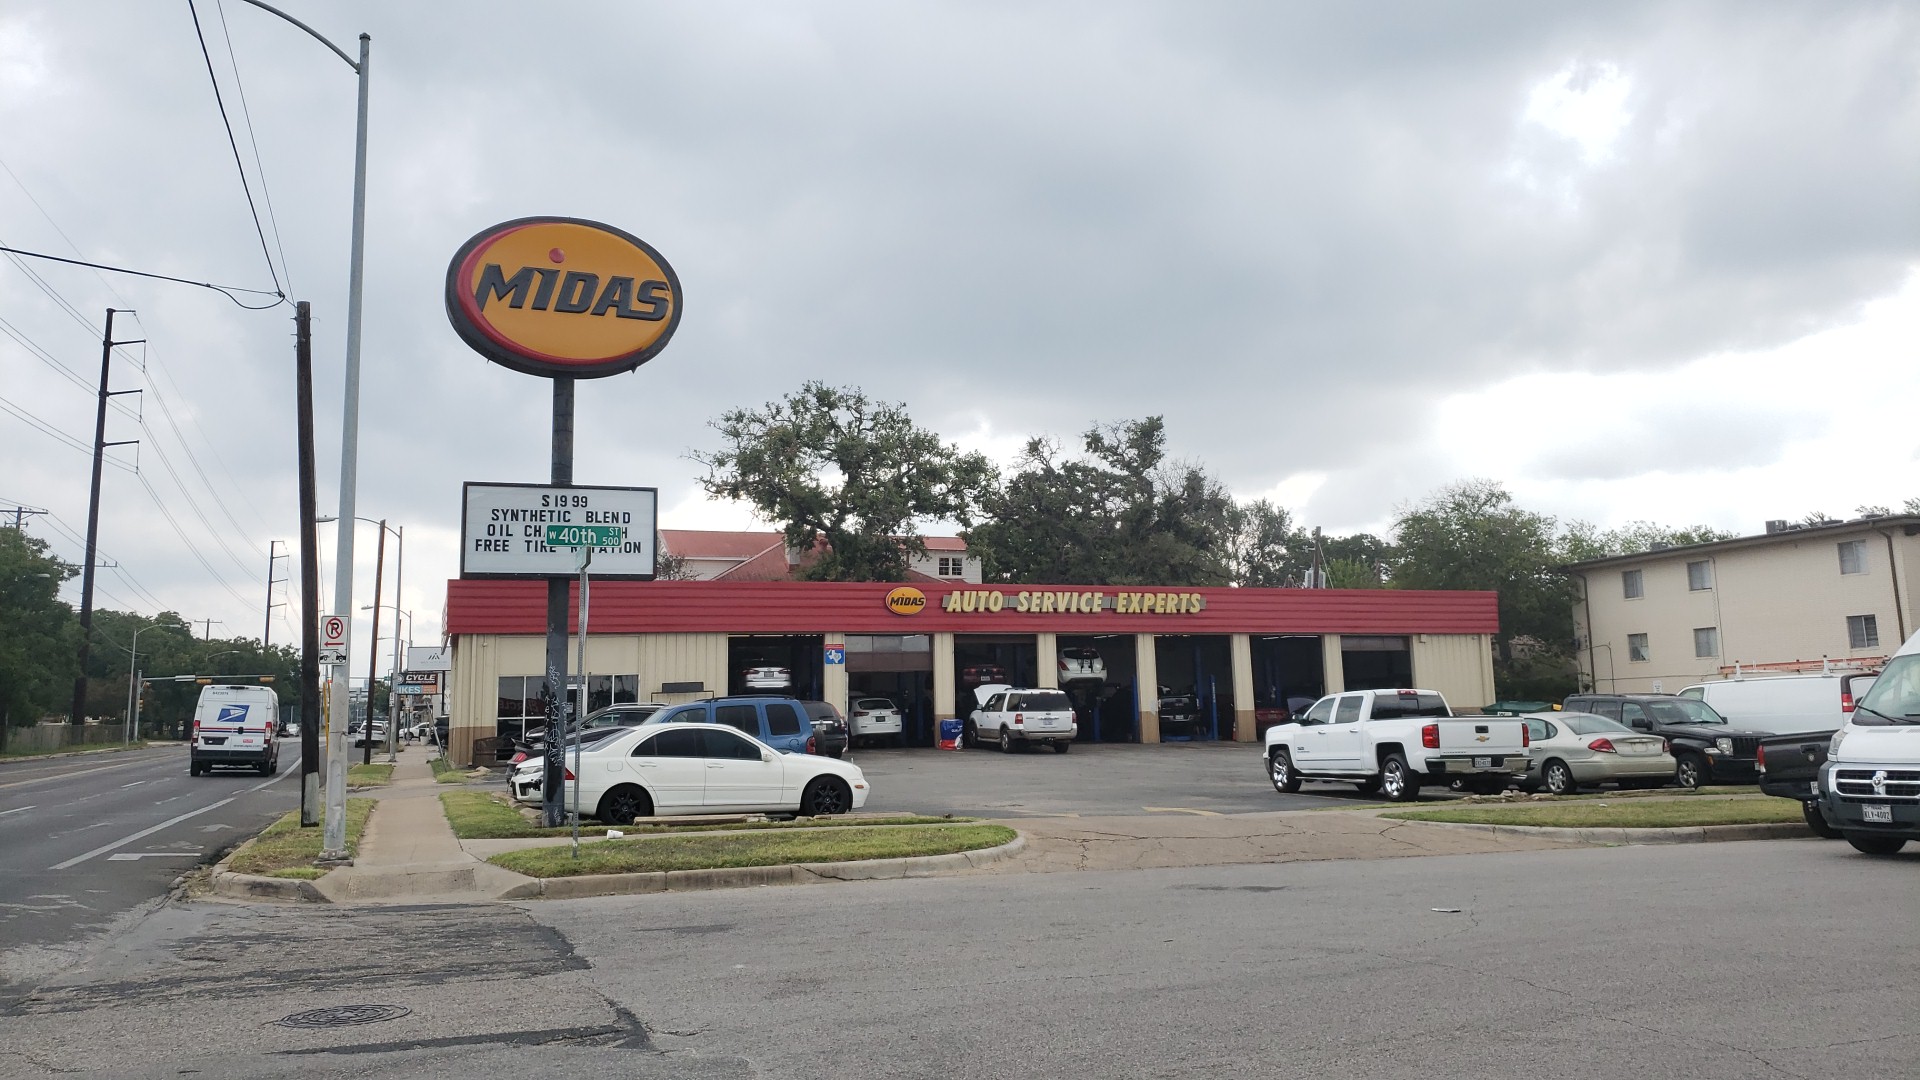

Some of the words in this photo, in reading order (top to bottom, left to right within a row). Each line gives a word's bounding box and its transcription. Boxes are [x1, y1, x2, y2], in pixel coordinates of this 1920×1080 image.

[475, 249, 670, 321] MIDAS
[491, 508, 571, 523] SYNTHETIC
[585, 511, 631, 524] BLEND
[487, 524, 513, 537] OIL
[549, 531, 556, 540] W
[558, 527, 597, 544] 40th
[609, 527, 620, 536] ST
[475, 539, 509, 552] FREE
[602, 537, 619, 545] 500
[890, 594, 925, 606] MIDAS
[946, 590, 1004, 613] AUTO
[1017, 591, 1104, 613] SERVICE
[1116, 592, 1201, 614] EXPERTS
[397, 686, 421, 694] IKES
